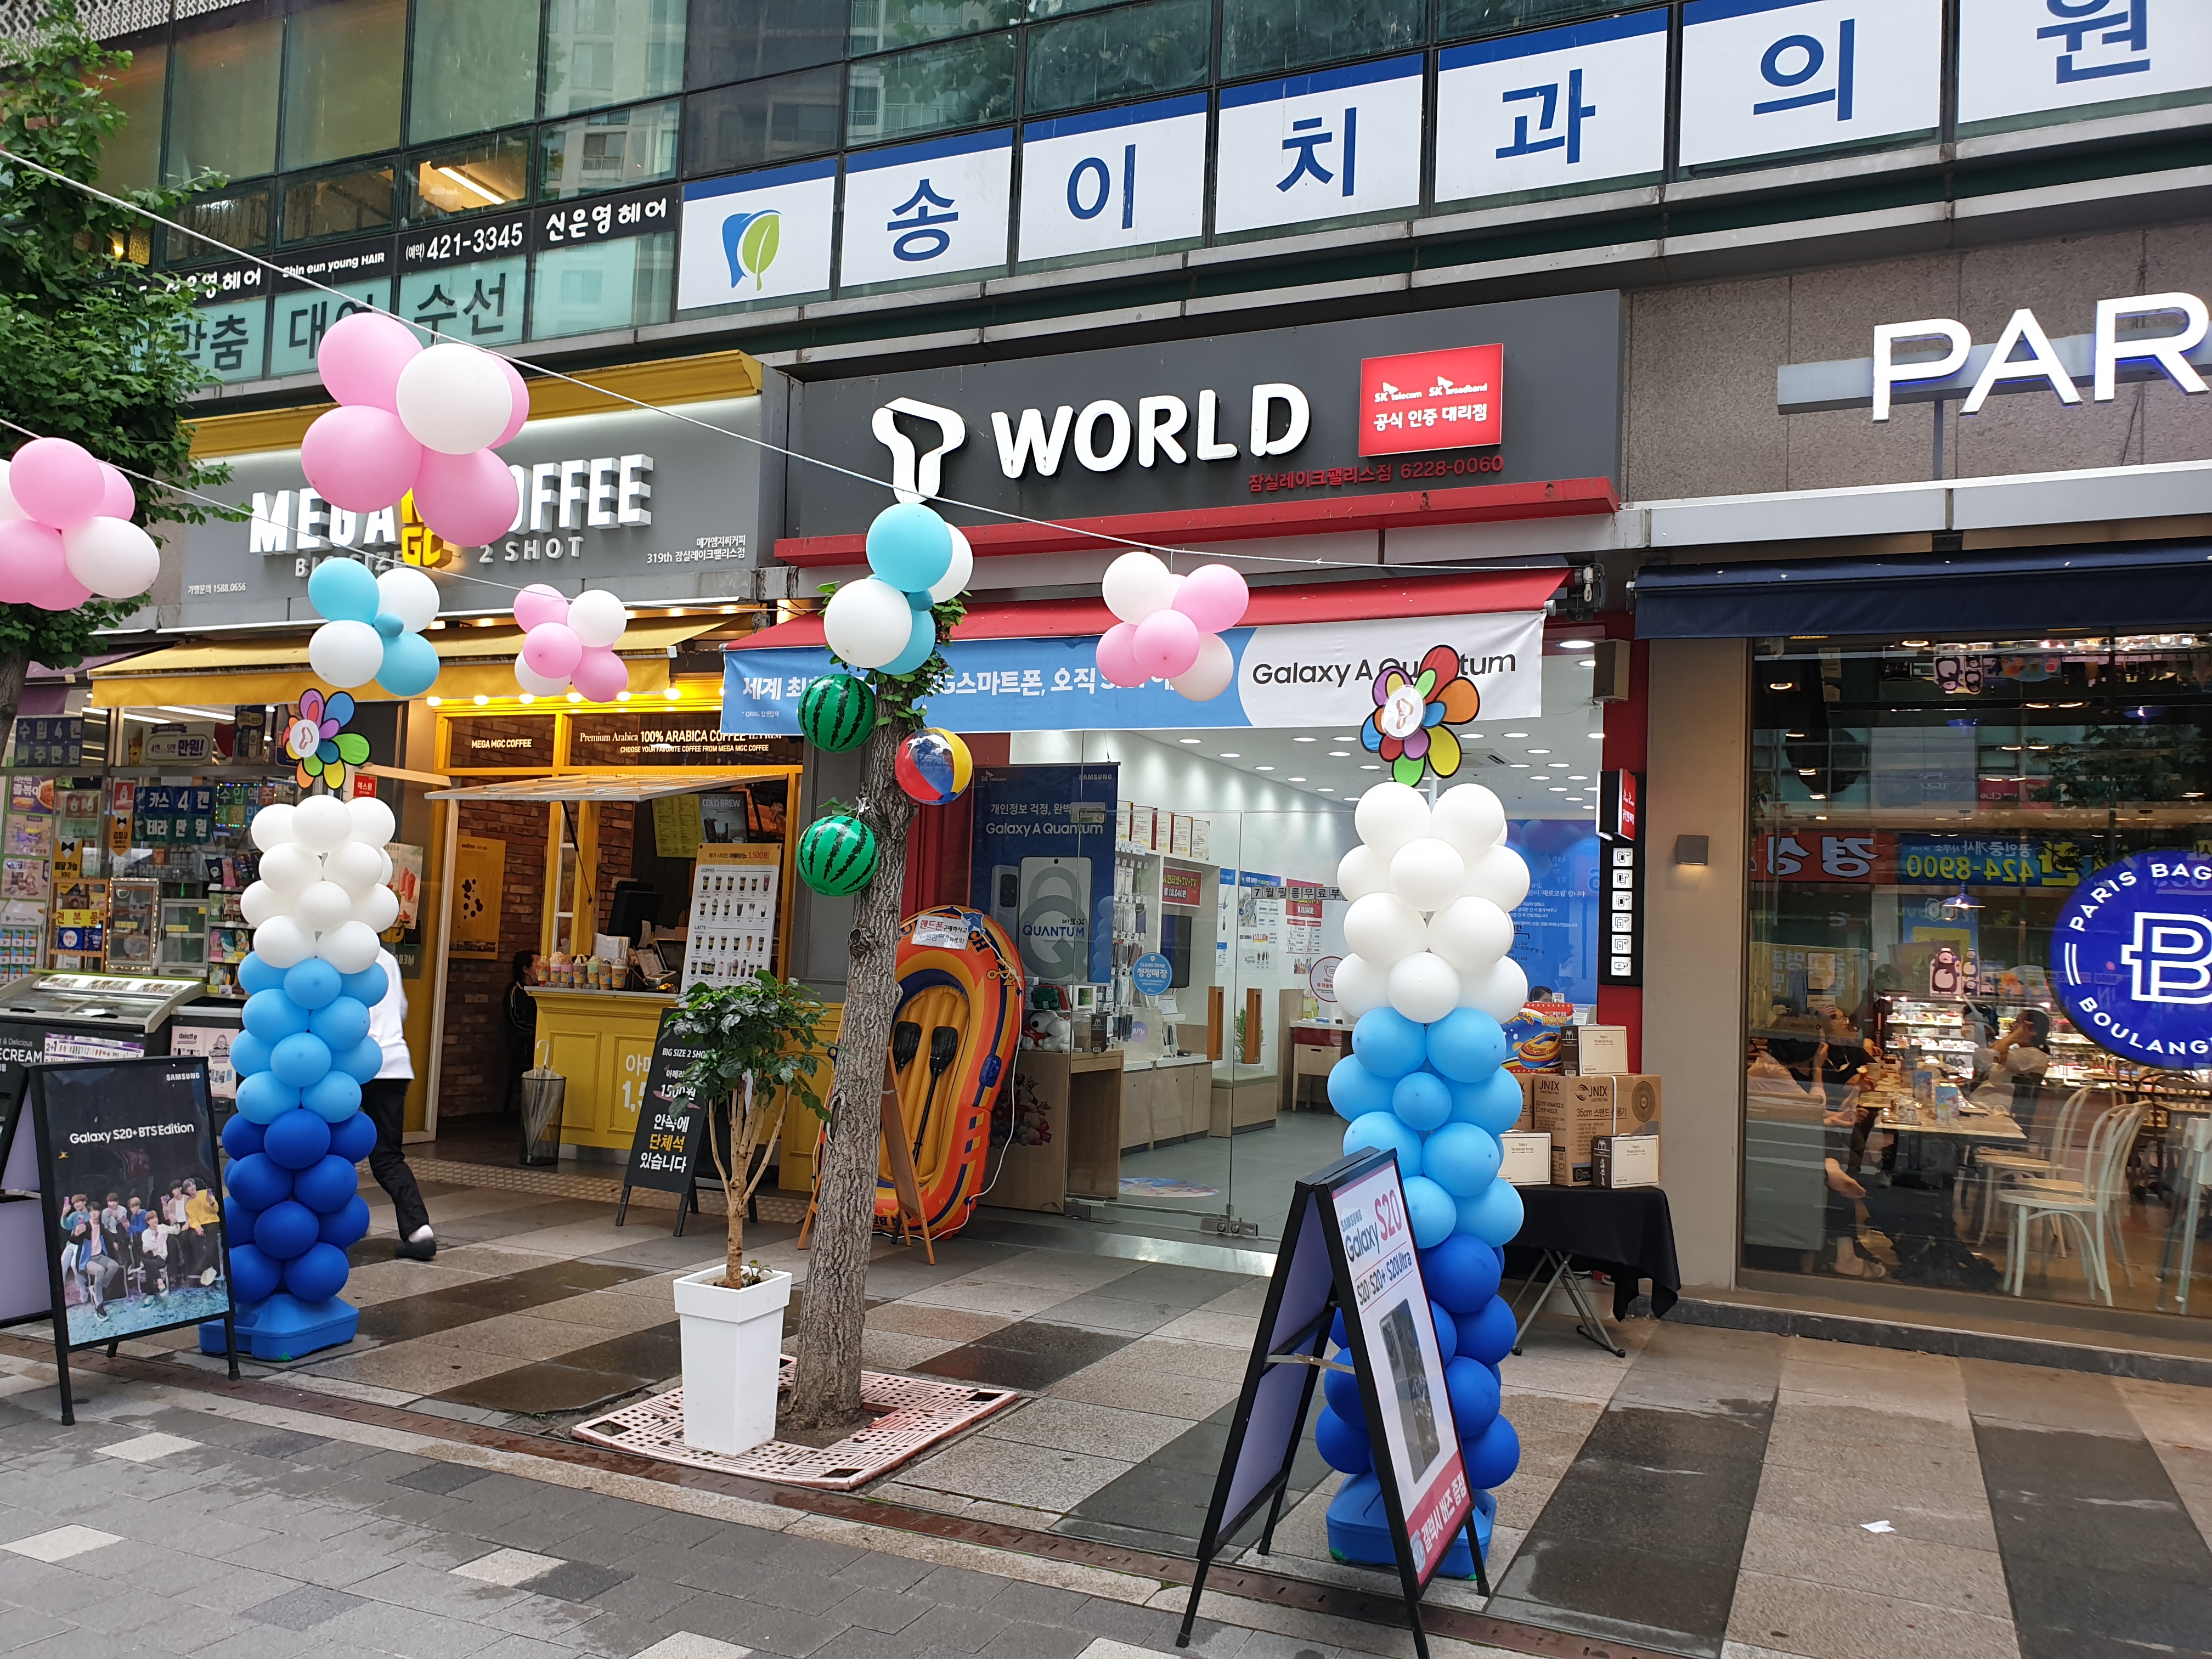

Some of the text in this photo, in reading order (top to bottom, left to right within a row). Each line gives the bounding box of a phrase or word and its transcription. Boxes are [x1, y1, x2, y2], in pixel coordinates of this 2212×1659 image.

[405, 222, 523, 262] (예약) 421-3345
[307, 262, 326, 274] eun
[328, 258, 359, 274] young
[361, 252, 385, 266] HAIR
[1873, 292, 2210, 423] PAR
[1374, 390, 1422, 403] SK telecom
[1429, 383, 1488, 397] SK broadband
[1374, 403, 1488, 431] 공식 인증 대리점
[991, 383, 1311, 479] WORLD
[1249, 454, 1504, 493] 잠실레이크팰리스점 6228-0060
[479, 544, 494, 563] 2
[505, 536, 584, 562] SHOT
[647, 552, 673, 564] 319th
[188, 584, 212, 595] 가맹문의
[1051, 667, 1096, 695] 오직
[1252, 659, 1373, 687] Galaxy A
[743, 676, 782, 701] 세계
[471, 738, 532, 749] MEGA MGC COFFEE
[579, 732, 611, 742] Premium
[612, 731, 638, 741] Arabica
[640, 731, 664, 743] 100%
[665, 730, 708, 743] ARABICA
[702, 798, 741, 808] COLD BREW
[991, 803, 1027, 815] 개인정보
[986, 822, 1103, 837] Galaxy A Quantum
[2069, 871, 2137, 932] PARIS
[1022, 924, 1085, 938] QUANTUM
[1137, 967, 1168, 979] 청정매장
[662, 1047, 673, 1057] BIG
[673, 1048, 686, 1058] SIZE
[686, 1049, 691, 1058] 2
[166, 1072, 200, 1081] SAMSUNG
[1539, 1080, 1560, 1091] JNIX
[1588, 1086, 1608, 1097] JNIX
[1576, 1108, 1593, 1117] 35cm
[70, 1122, 194, 1144] Galaxy S20+ BTS Edition
[649, 1133, 686, 1152] 단체석
[639, 1152, 687, 1173] 있습니다
[1340, 1209, 1363, 1233] SAMSUNG
[1345, 1189, 1402, 1262] Galaxy S20
[1421, 1470, 1467, 1554] 갤럭시 버즈 증정
